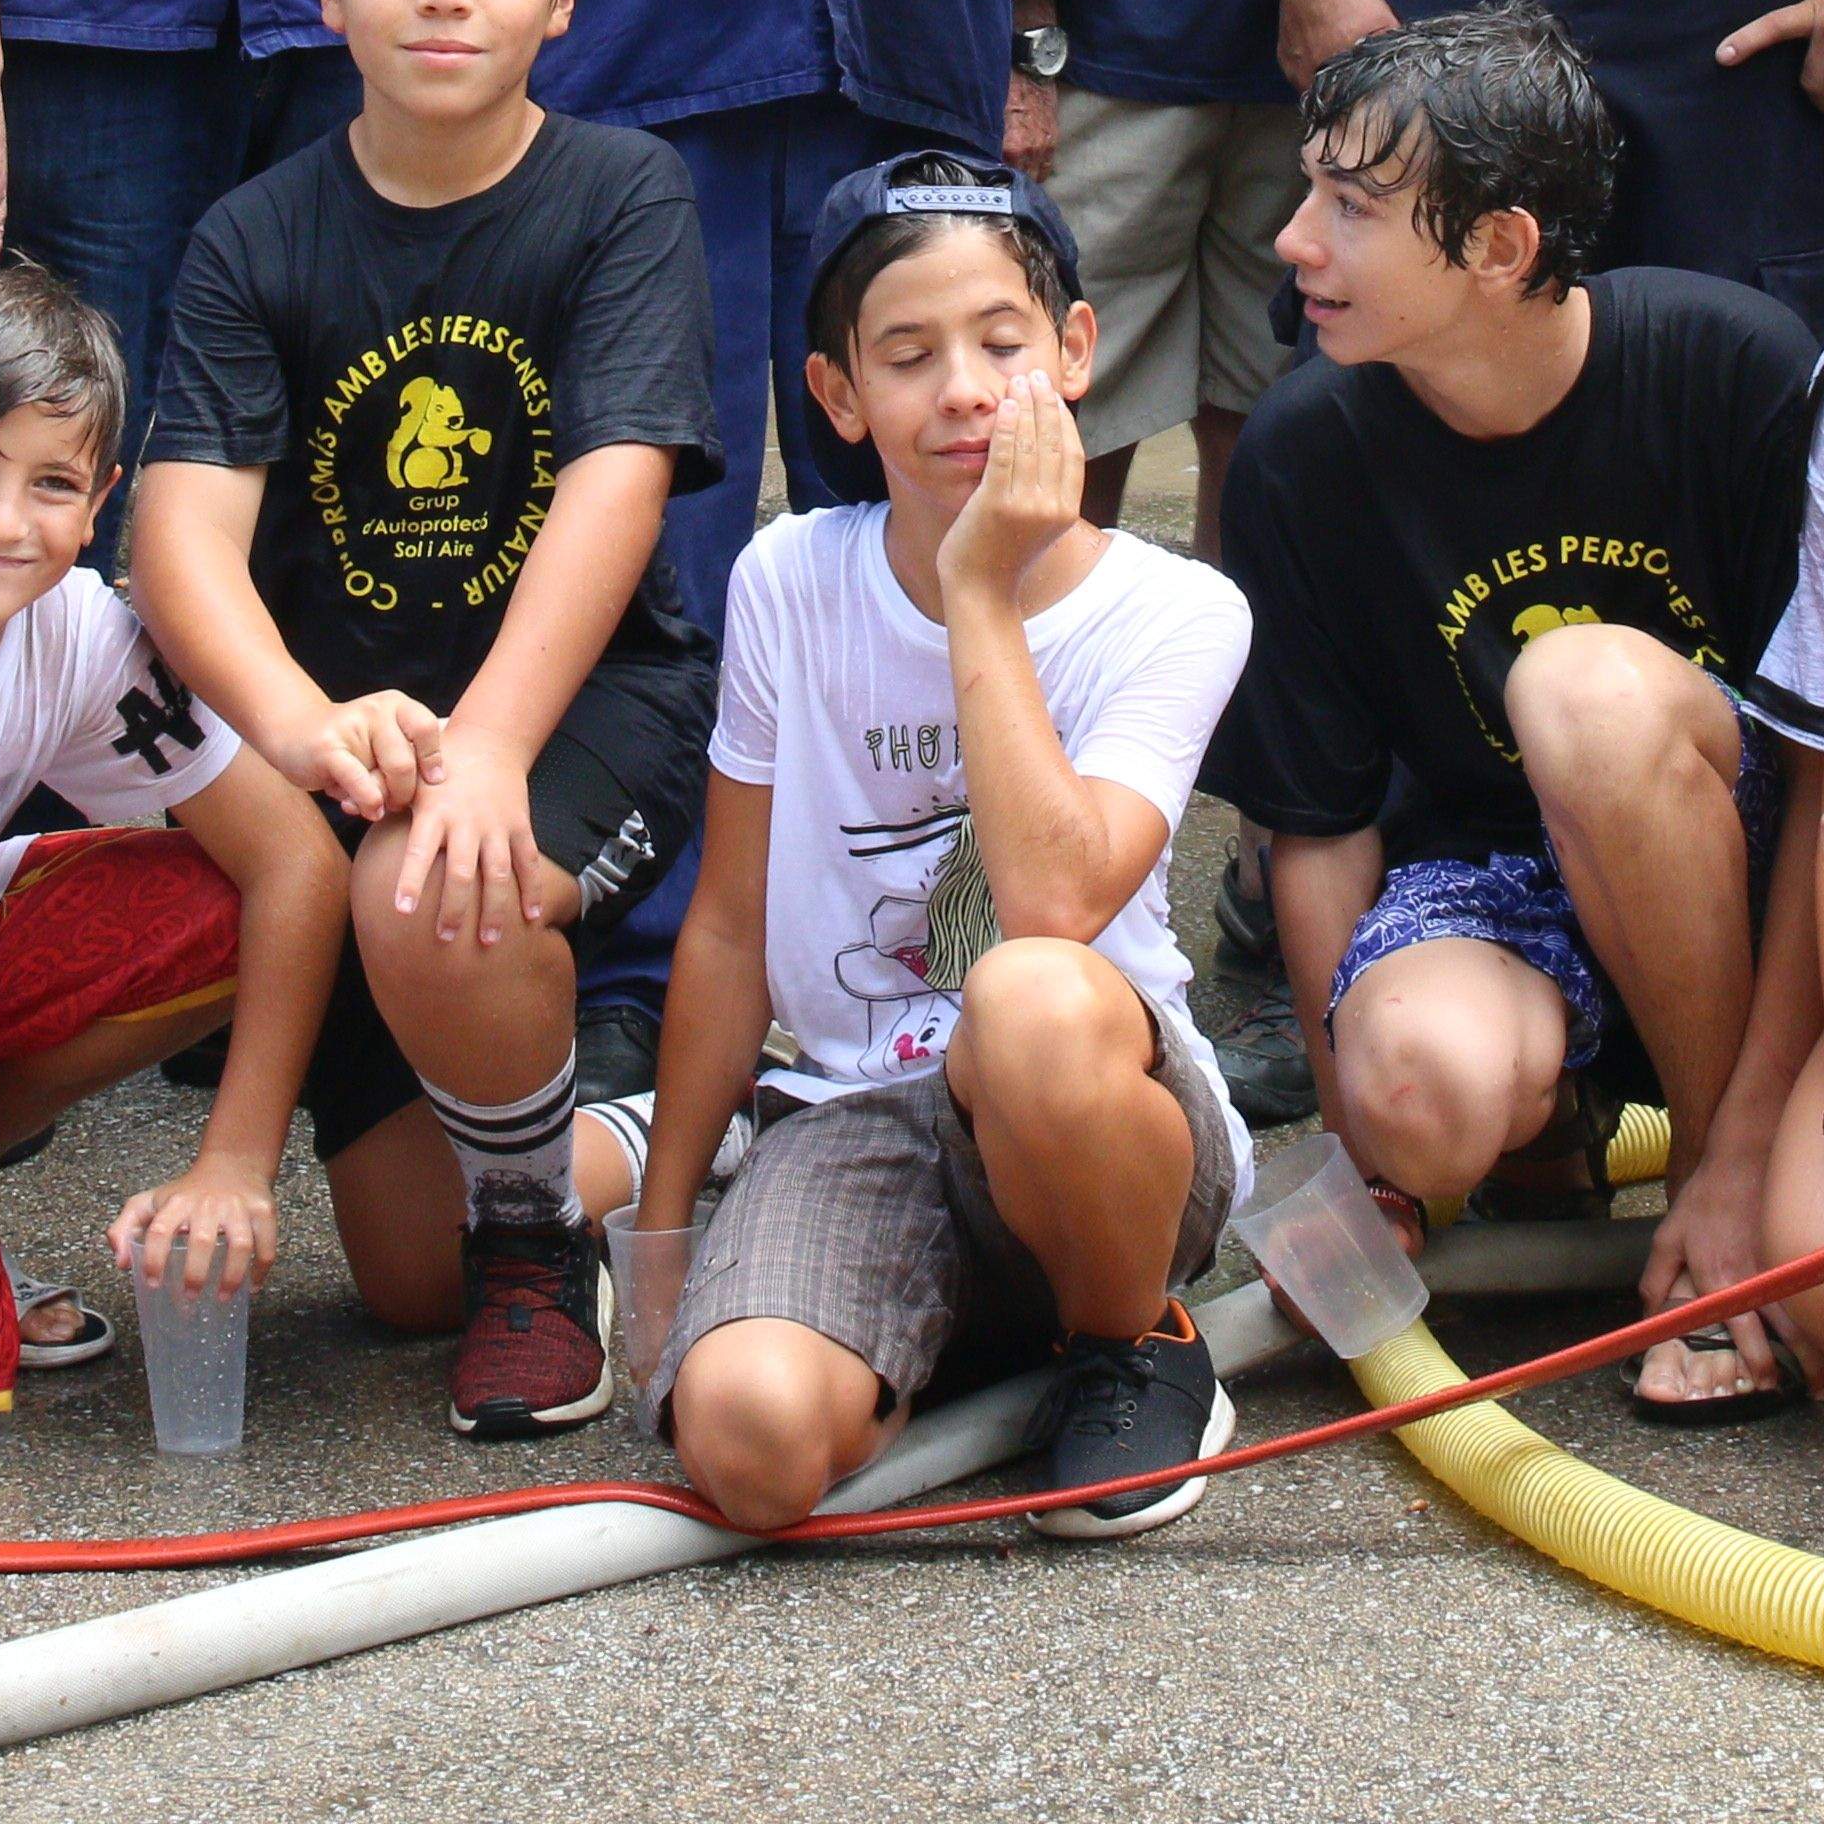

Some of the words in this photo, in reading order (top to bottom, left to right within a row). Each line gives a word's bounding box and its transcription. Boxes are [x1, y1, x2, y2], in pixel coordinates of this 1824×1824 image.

[386, 316, 434, 363] LES
[323, 349, 388, 425] AMB
[529, 447, 558, 490] LA
[408, 494, 460, 511] Grup
[394, 540, 423, 559] Sol
[436, 539, 475, 558] Aire
[462, 500, 549, 607] NATUR
[1436, 572, 1492, 652] AMB
[1491, 543, 1549, 586] LES
[1559, 535, 1706, 631] PERSOES
